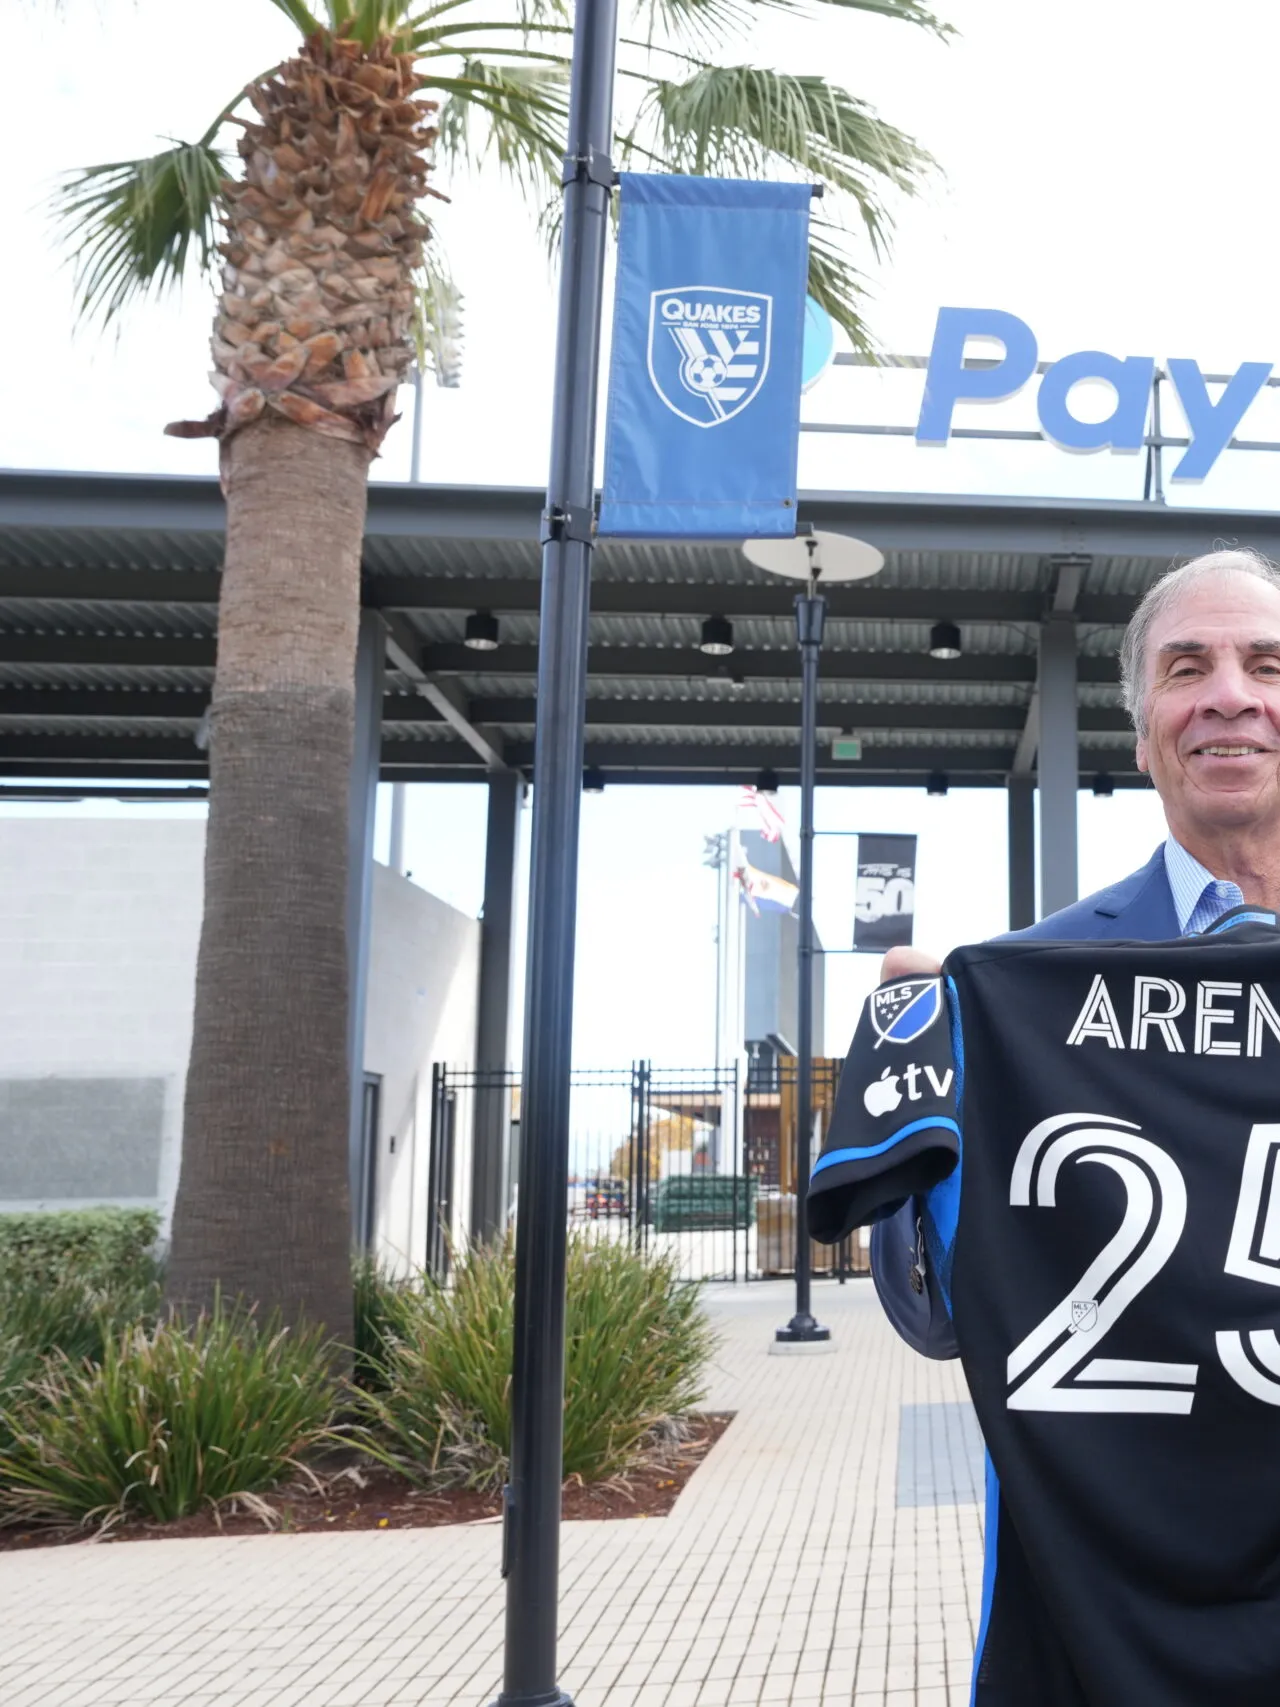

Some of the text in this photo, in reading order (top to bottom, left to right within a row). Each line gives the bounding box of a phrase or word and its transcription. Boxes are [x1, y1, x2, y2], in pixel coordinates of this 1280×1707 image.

[661, 298, 761, 323] QUAKES
[856, 877, 914, 923] 50
[876, 986, 913, 1008] MLS
[903, 1063, 954, 1101] tv
